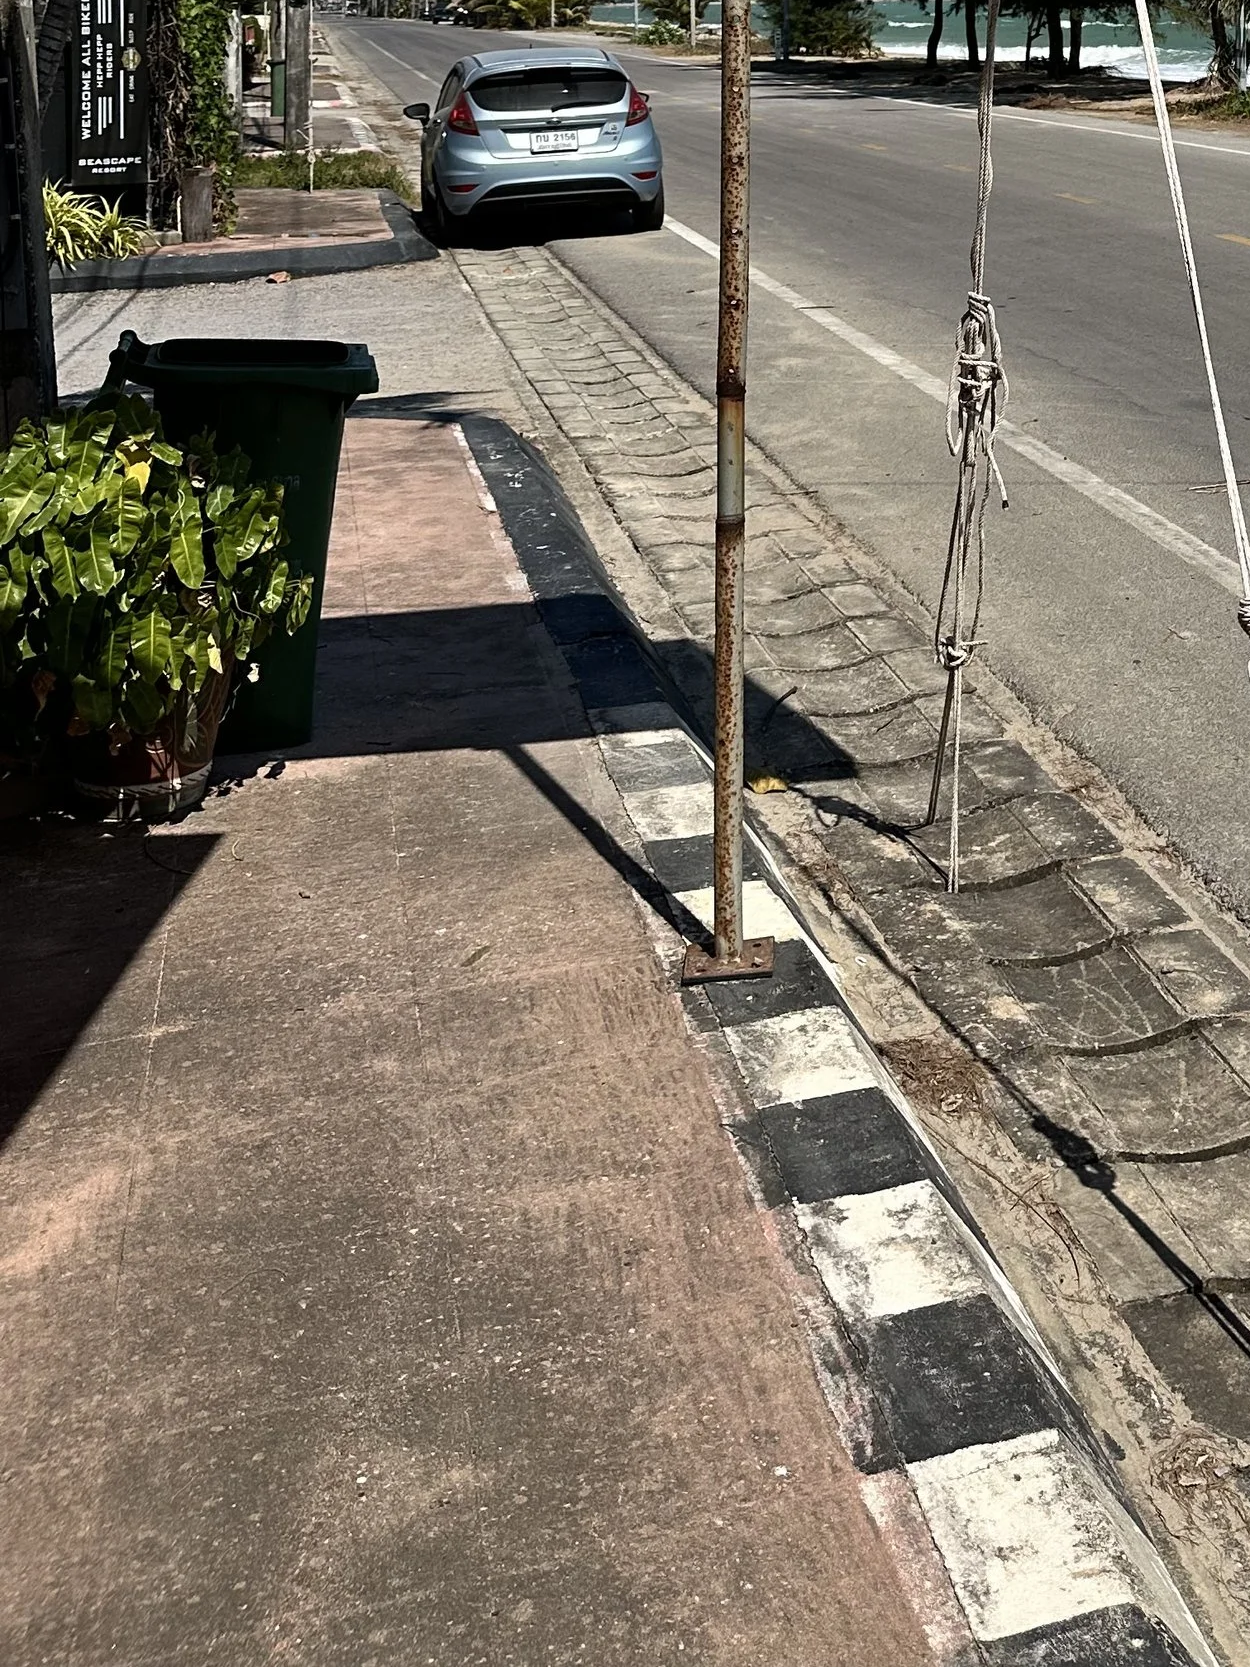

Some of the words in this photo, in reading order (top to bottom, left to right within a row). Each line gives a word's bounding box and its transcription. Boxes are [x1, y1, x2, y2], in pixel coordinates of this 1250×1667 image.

[81, 40, 91, 66] ALL
[105, 43, 113, 78] RIDERS
[96, 62, 104, 88] HEPP
[81, 70, 92, 140] WELCOME
[78, 157, 142, 166] SEASCAPE
